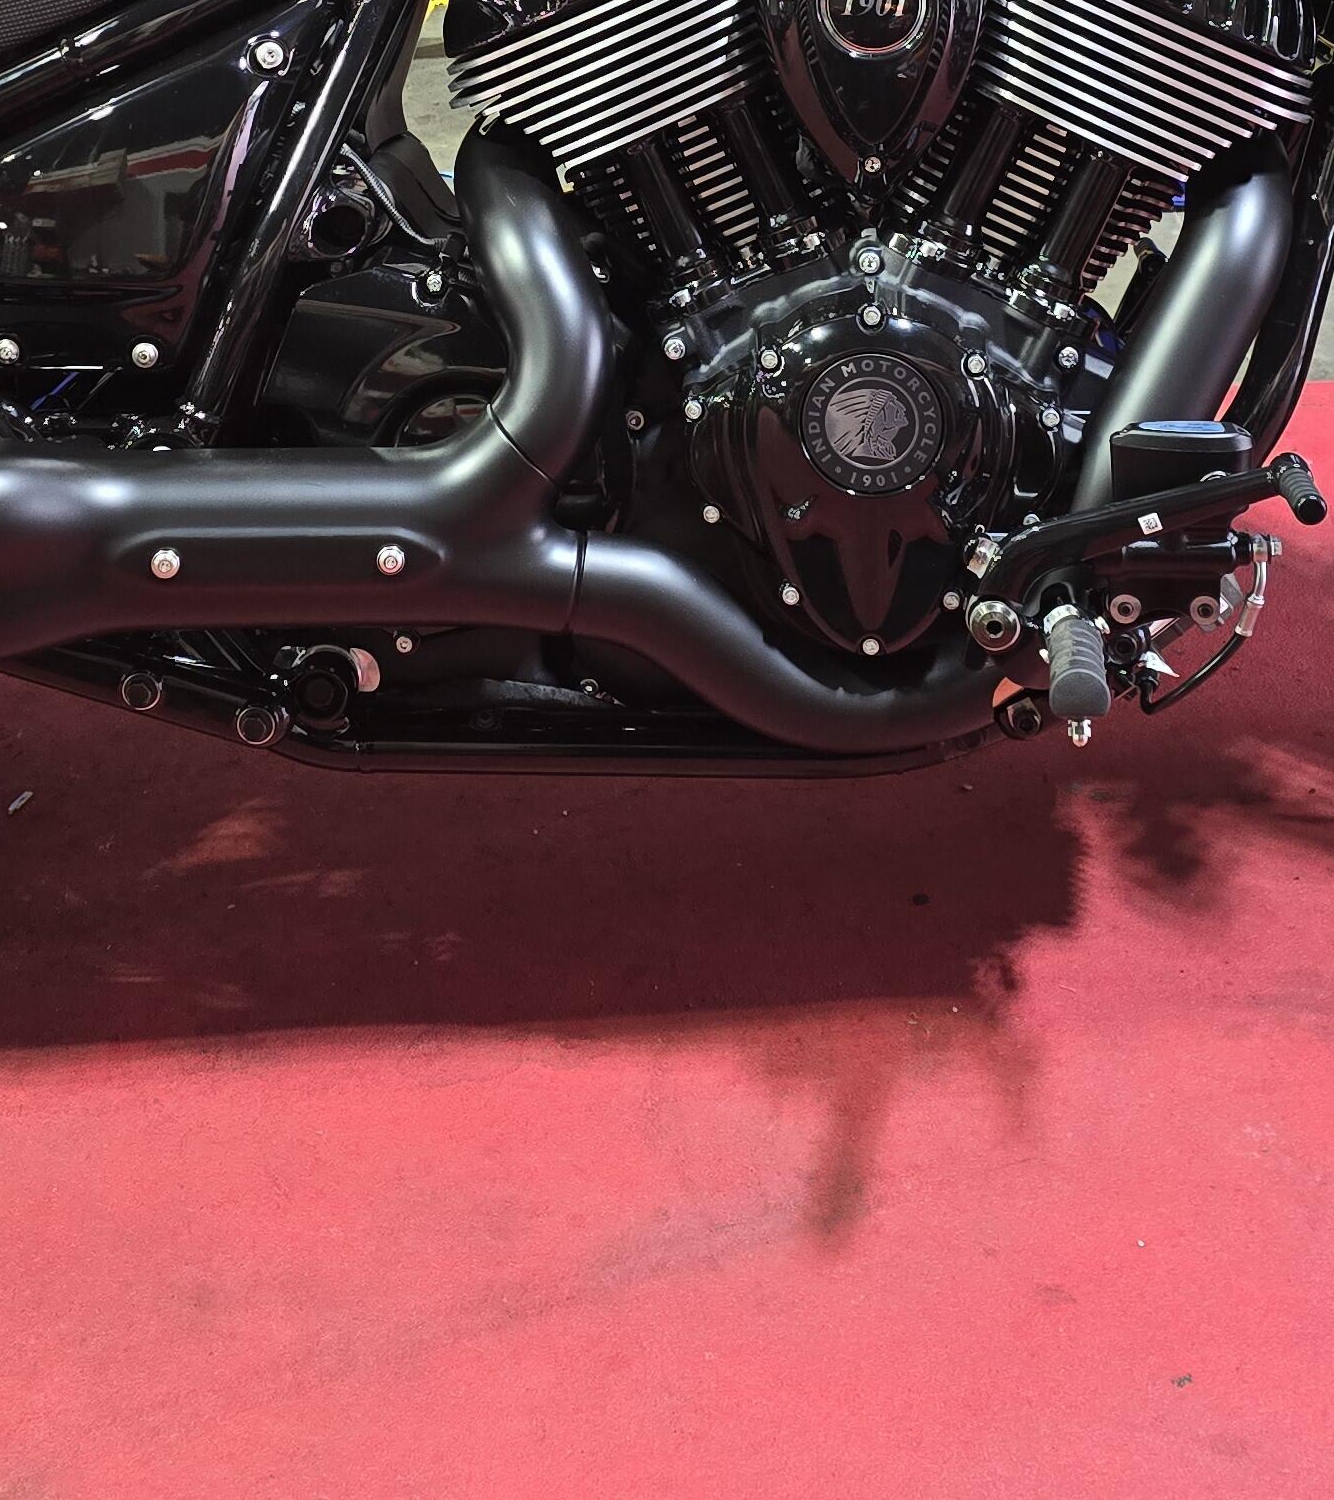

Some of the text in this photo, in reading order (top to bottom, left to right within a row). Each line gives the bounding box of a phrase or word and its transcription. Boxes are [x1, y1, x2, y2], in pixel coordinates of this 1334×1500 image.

[808, 359, 937, 463] INDIAN MOTORCYCLE
[850, 472, 898, 487] 1901
